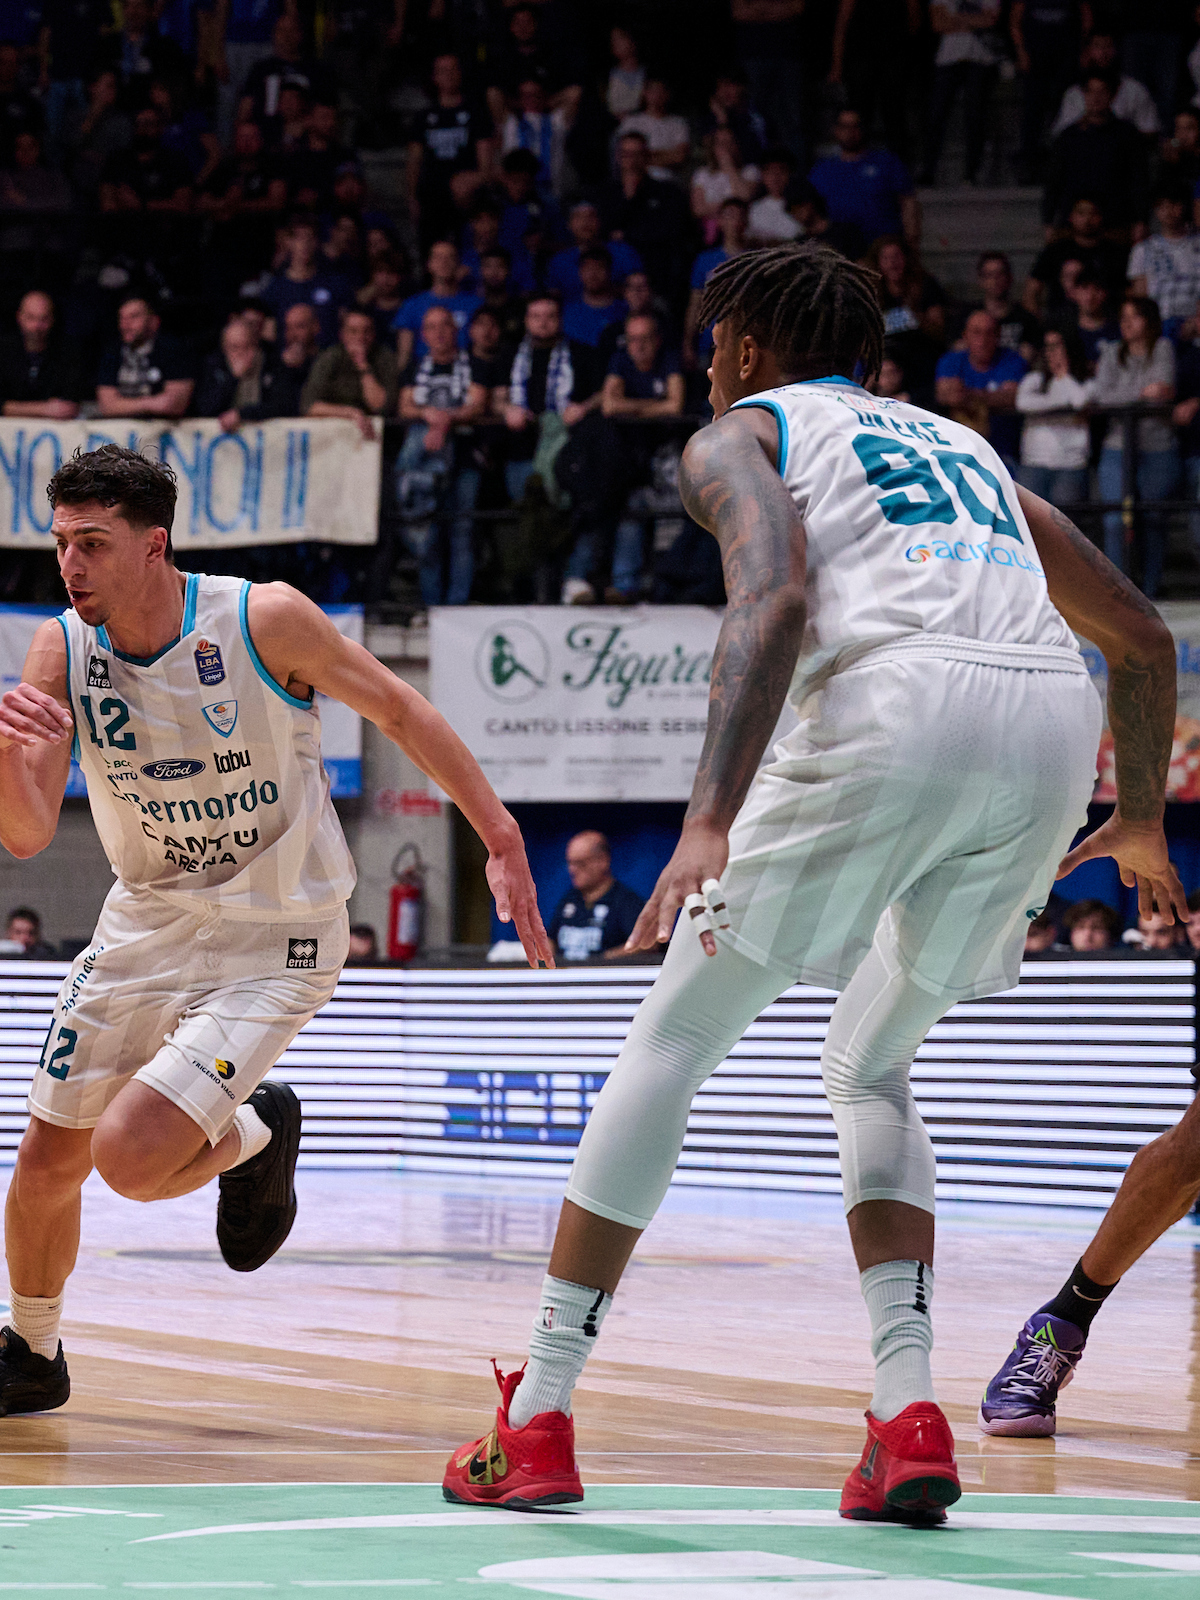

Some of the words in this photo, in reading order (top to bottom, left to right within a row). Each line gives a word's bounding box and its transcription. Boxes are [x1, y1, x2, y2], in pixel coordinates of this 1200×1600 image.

[851, 433, 1025, 546] 90
[199, 657, 220, 668] LBA
[203, 671, 223, 682] Unipol
[80, 694, 137, 751] 12
[153, 762, 192, 778] Ford
[213, 749, 251, 774] tabu
[164, 850, 238, 873] ARENA
[288, 958, 315, 968] errea
[192, 1060, 221, 1085] FRIGERIO
